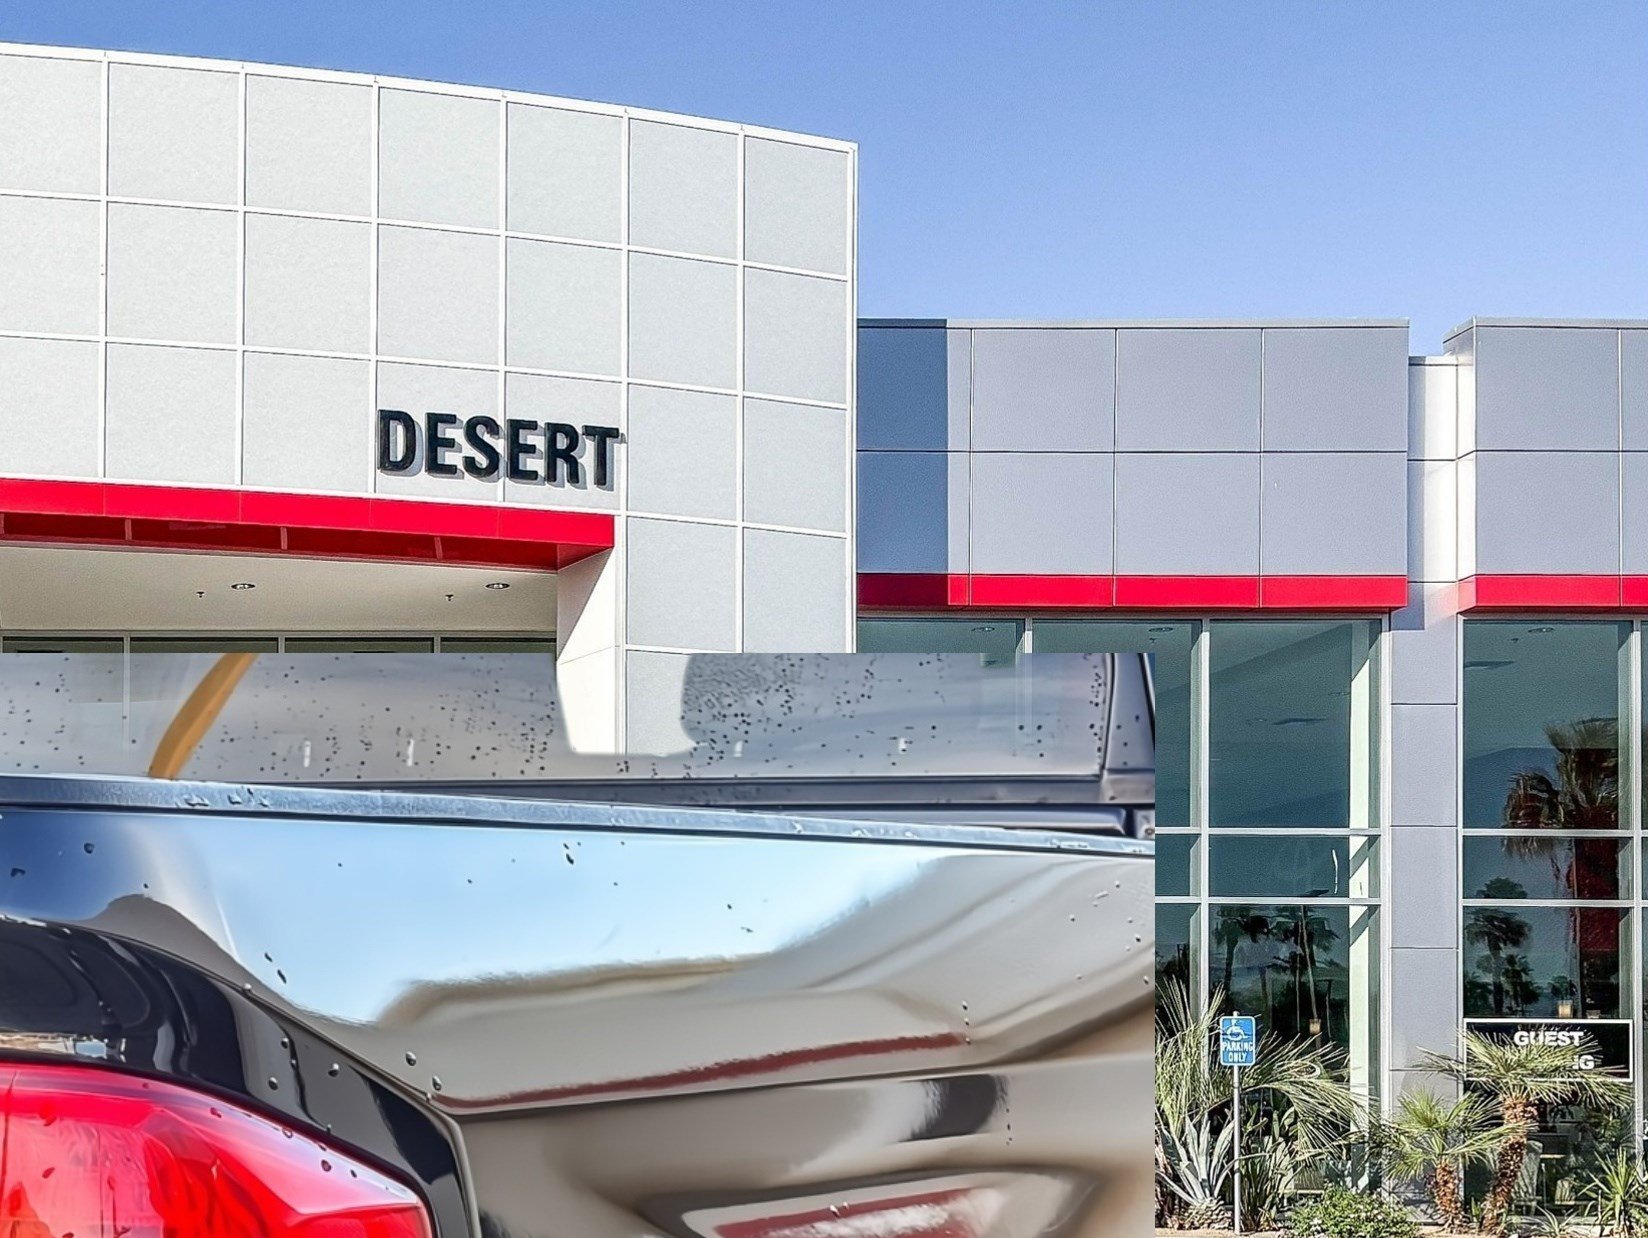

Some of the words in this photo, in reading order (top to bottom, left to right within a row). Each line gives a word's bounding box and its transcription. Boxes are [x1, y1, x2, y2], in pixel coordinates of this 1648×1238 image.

[377, 409, 620, 487] DESERT
[1513, 1030, 1585, 1047] GUEST
[1222, 1041, 1254, 1052] PARKING
[1228, 1052, 1247, 1062] ONLY
